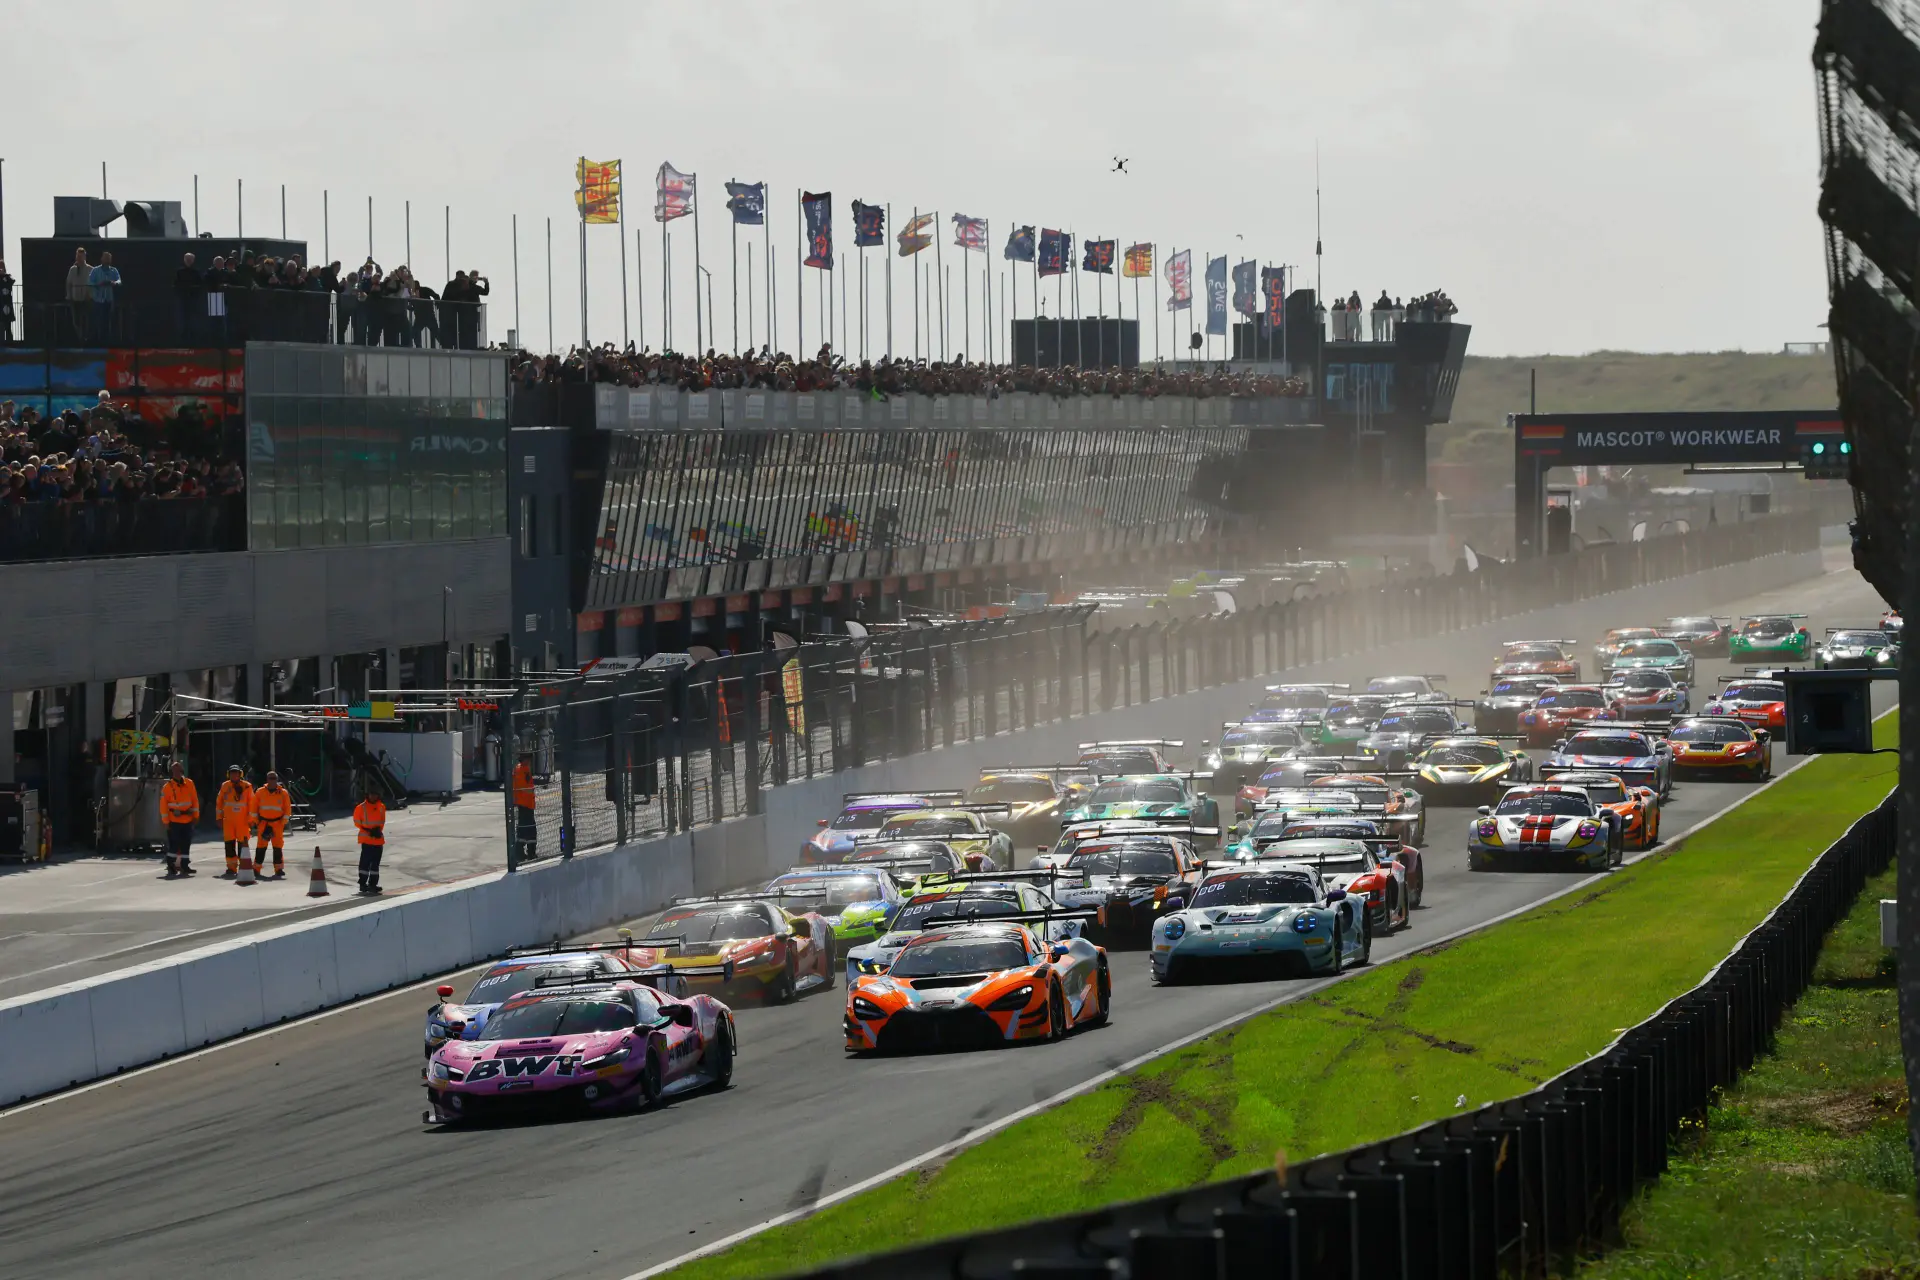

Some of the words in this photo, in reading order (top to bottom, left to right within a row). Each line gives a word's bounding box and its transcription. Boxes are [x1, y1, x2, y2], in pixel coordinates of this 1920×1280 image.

[1671, 429, 1780, 446] WORKWEAR
[1803, 714, 1809, 723] 2
[1240, 873, 1309, 881] WORLD
[1198, 882, 1226, 896] 006
[902, 903, 934, 917] 004
[651, 920, 678, 934] 005
[479, 973, 512, 989] 003
[549, 989, 573, 997] Frey
[463, 1054, 585, 1083] BWT
